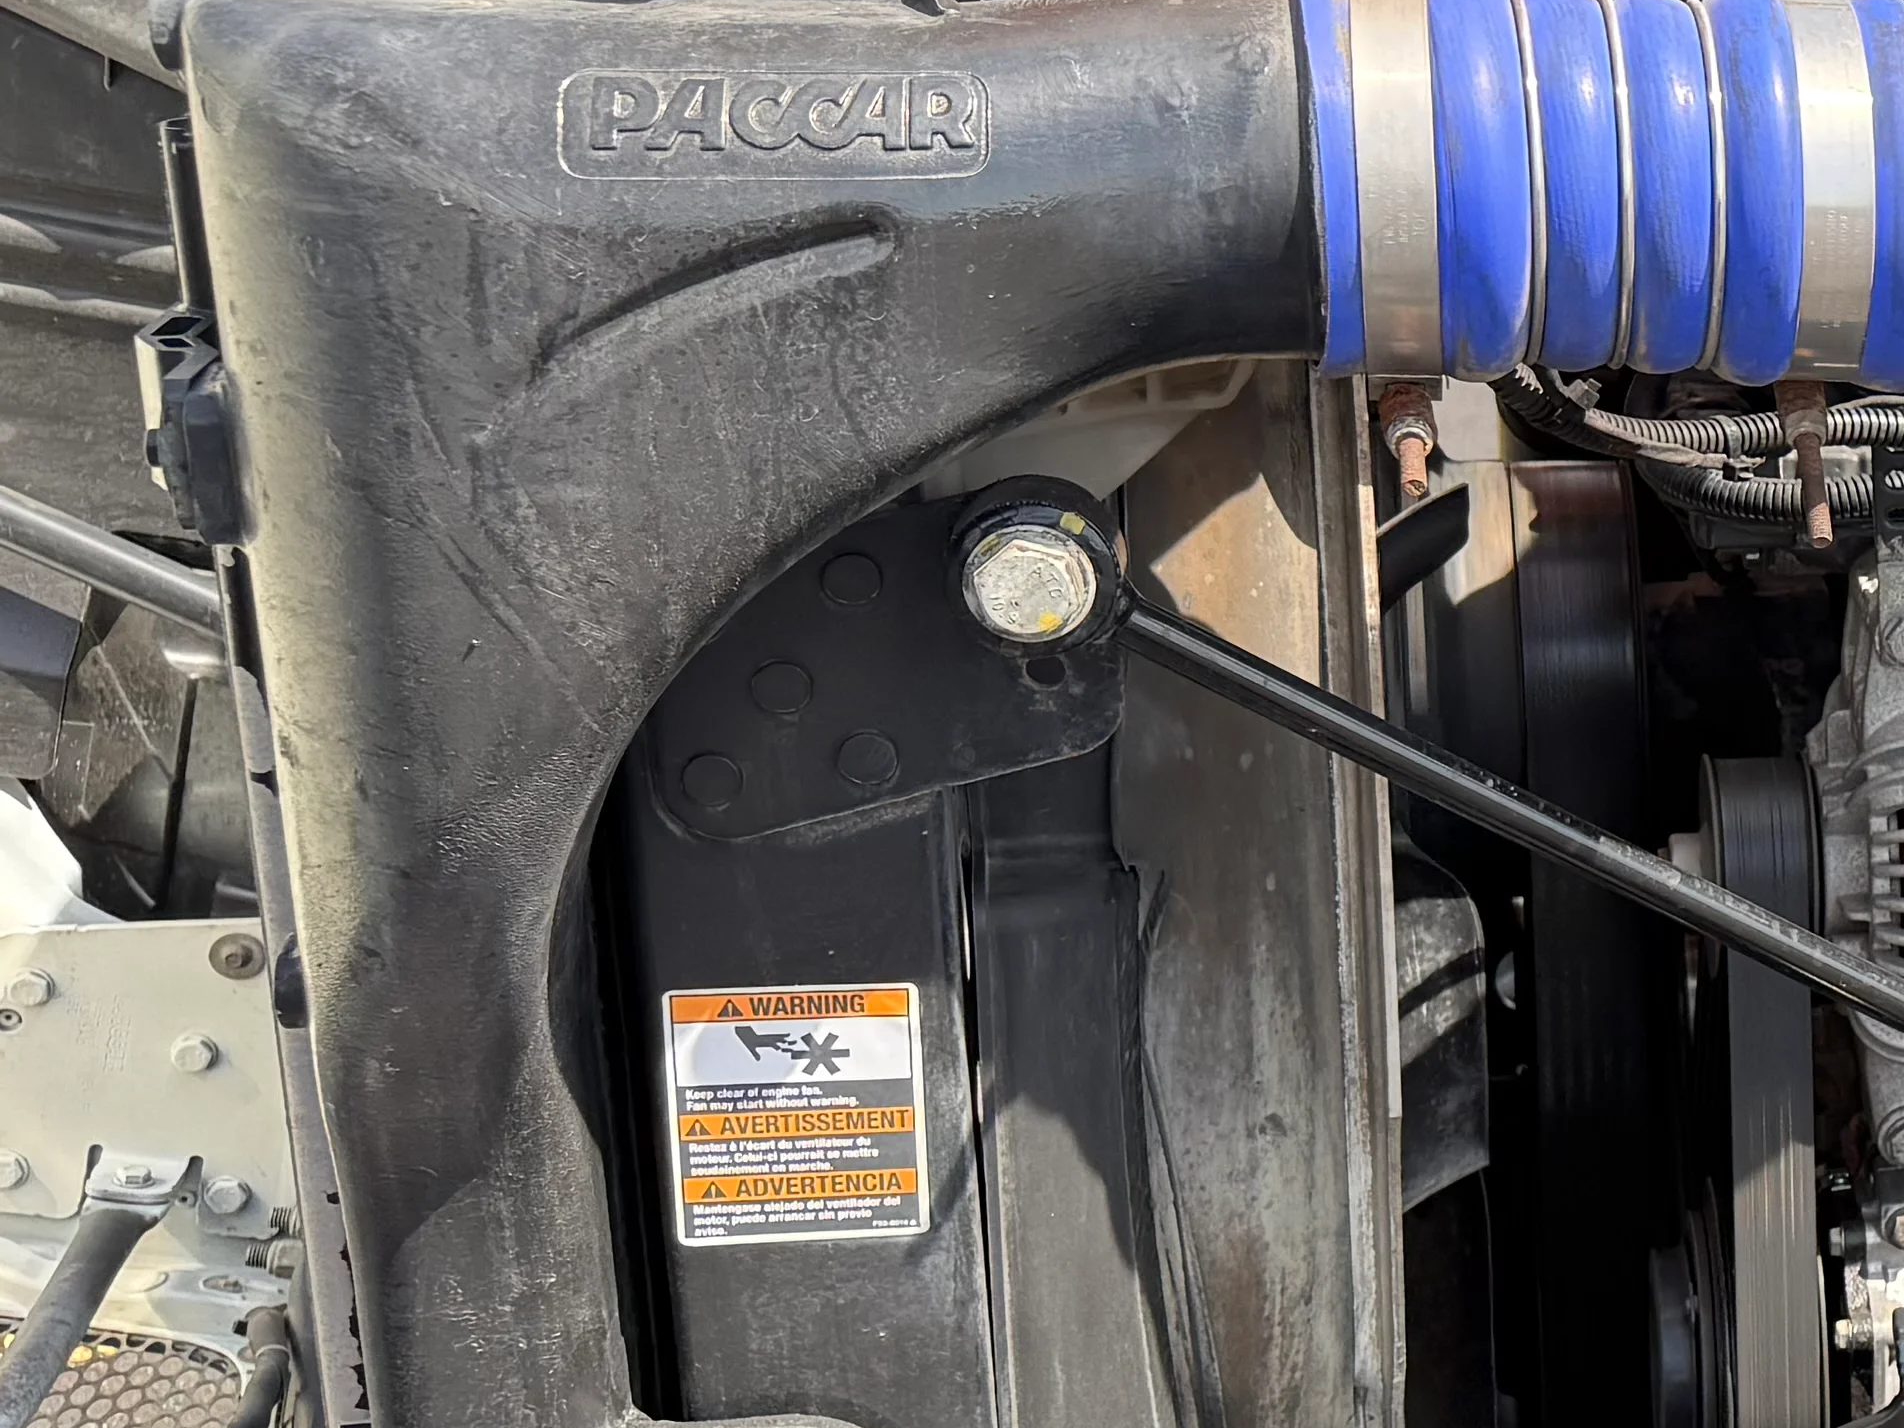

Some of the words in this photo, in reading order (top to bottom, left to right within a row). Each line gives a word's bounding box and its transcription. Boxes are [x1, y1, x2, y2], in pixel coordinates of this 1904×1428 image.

[591, 75, 976, 151] PACCAR
[748, 993, 866, 1017] WARNING
[719, 1109, 910, 1136] AVERTISSEMENT
[735, 1172, 902, 1198] ADVERTENCIA
